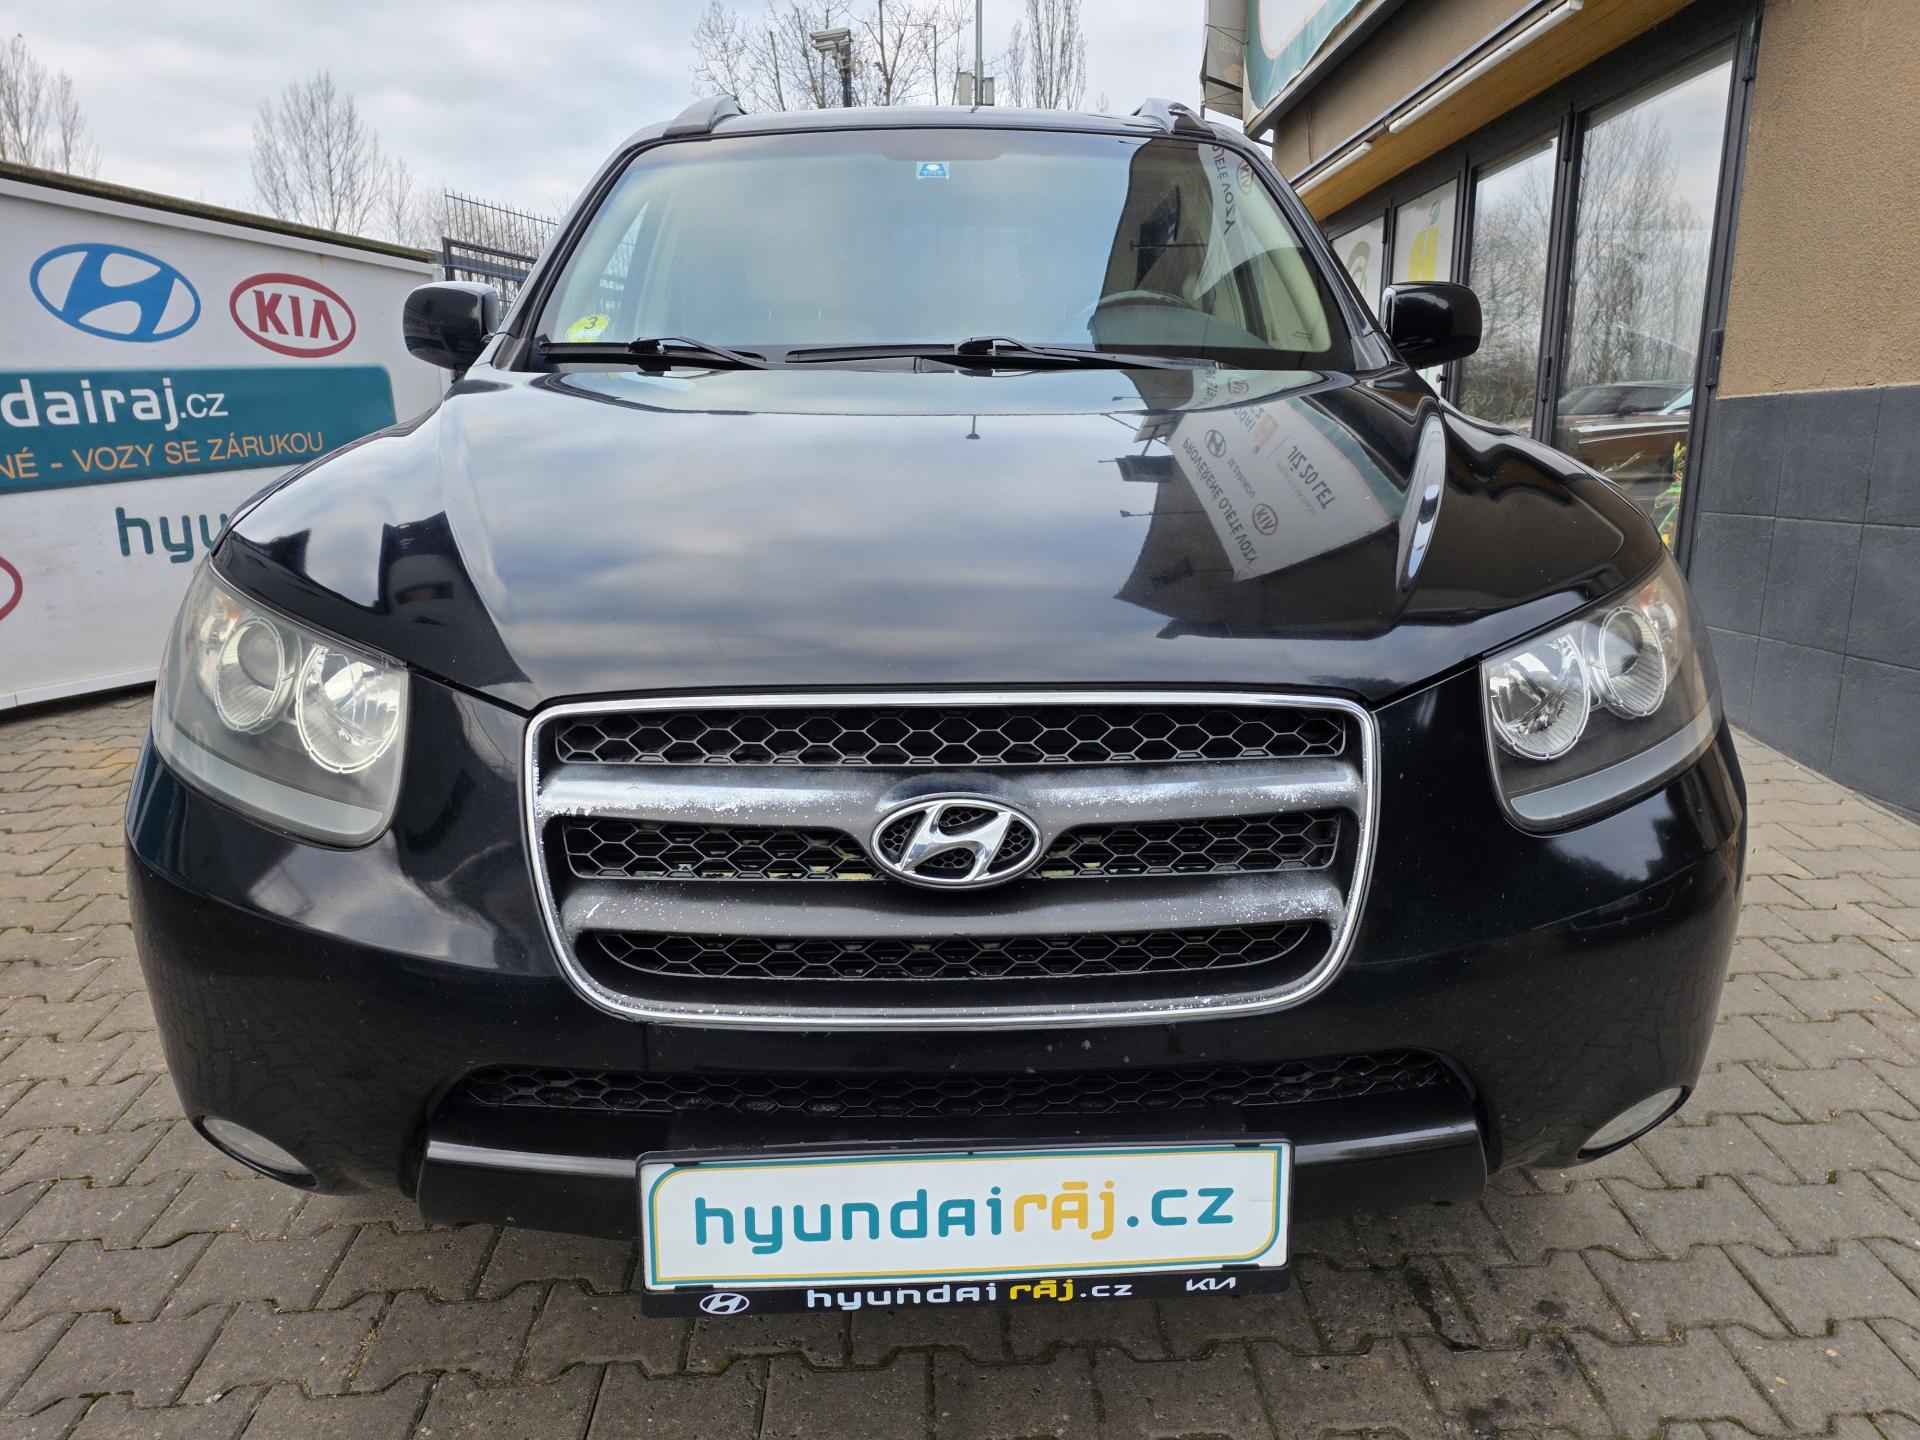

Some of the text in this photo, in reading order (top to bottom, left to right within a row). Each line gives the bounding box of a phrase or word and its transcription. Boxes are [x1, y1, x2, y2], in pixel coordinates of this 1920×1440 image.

[252, 289, 339, 342] KIA
[583, 316, 599, 330] 3
[71, 444, 155, 473] VOZY
[165, 440, 200, 464] SE
[208, 431, 324, 461] ZÁRUKOU
